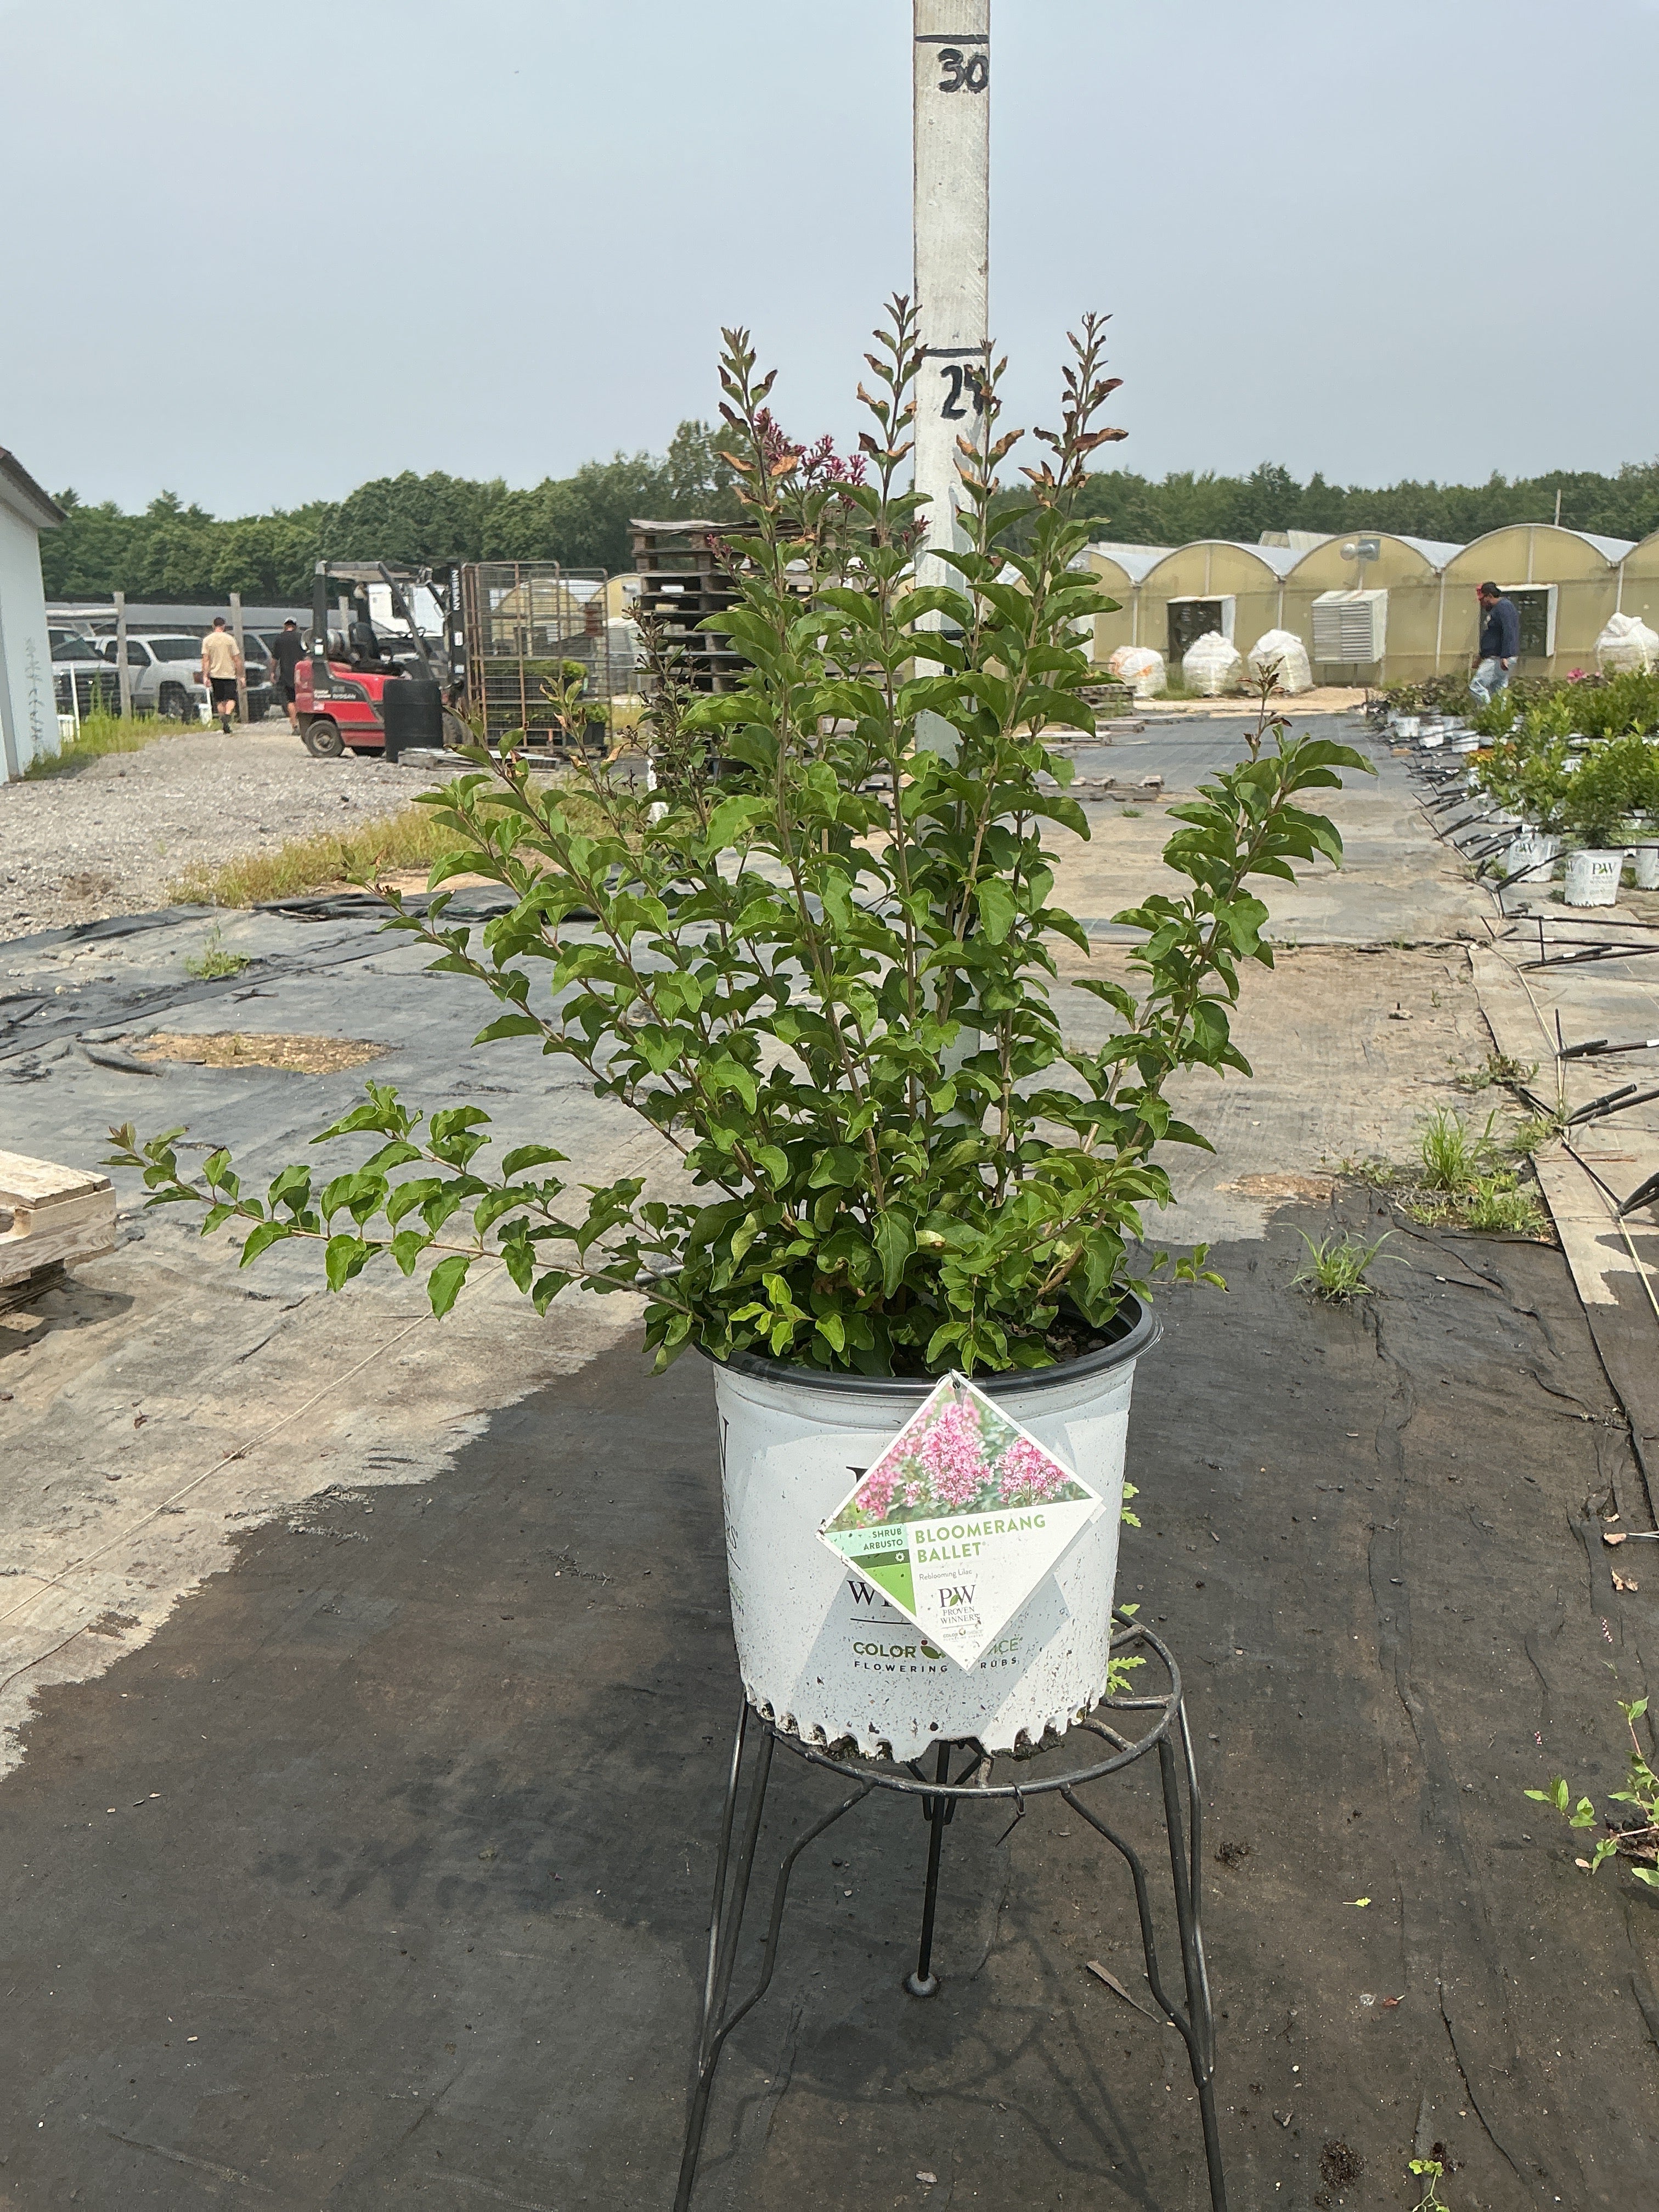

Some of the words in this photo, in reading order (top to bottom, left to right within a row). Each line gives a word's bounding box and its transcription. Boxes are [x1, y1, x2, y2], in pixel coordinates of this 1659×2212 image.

[937, 48, 989, 94] 30
[940, 364, 986, 420] 24
[452, 569, 460, 610] NISSAN
[872, 1528, 902, 1538] SHRUB
[915, 1514, 1046, 1544] BLOOMERANG
[864, 1539, 903, 1550] ARBUSTO
[918, 1542, 981, 1563] BALLET
[919, 1571, 957, 1581] Reblooming
[938, 1584, 977, 1608] PW
[943, 1606, 975, 1616] PROVEN
[853, 1641, 917, 1658] COLOR
[854, 1661, 949, 1673] FLOWERING
[980, 1657, 1017, 1669] RUBS
